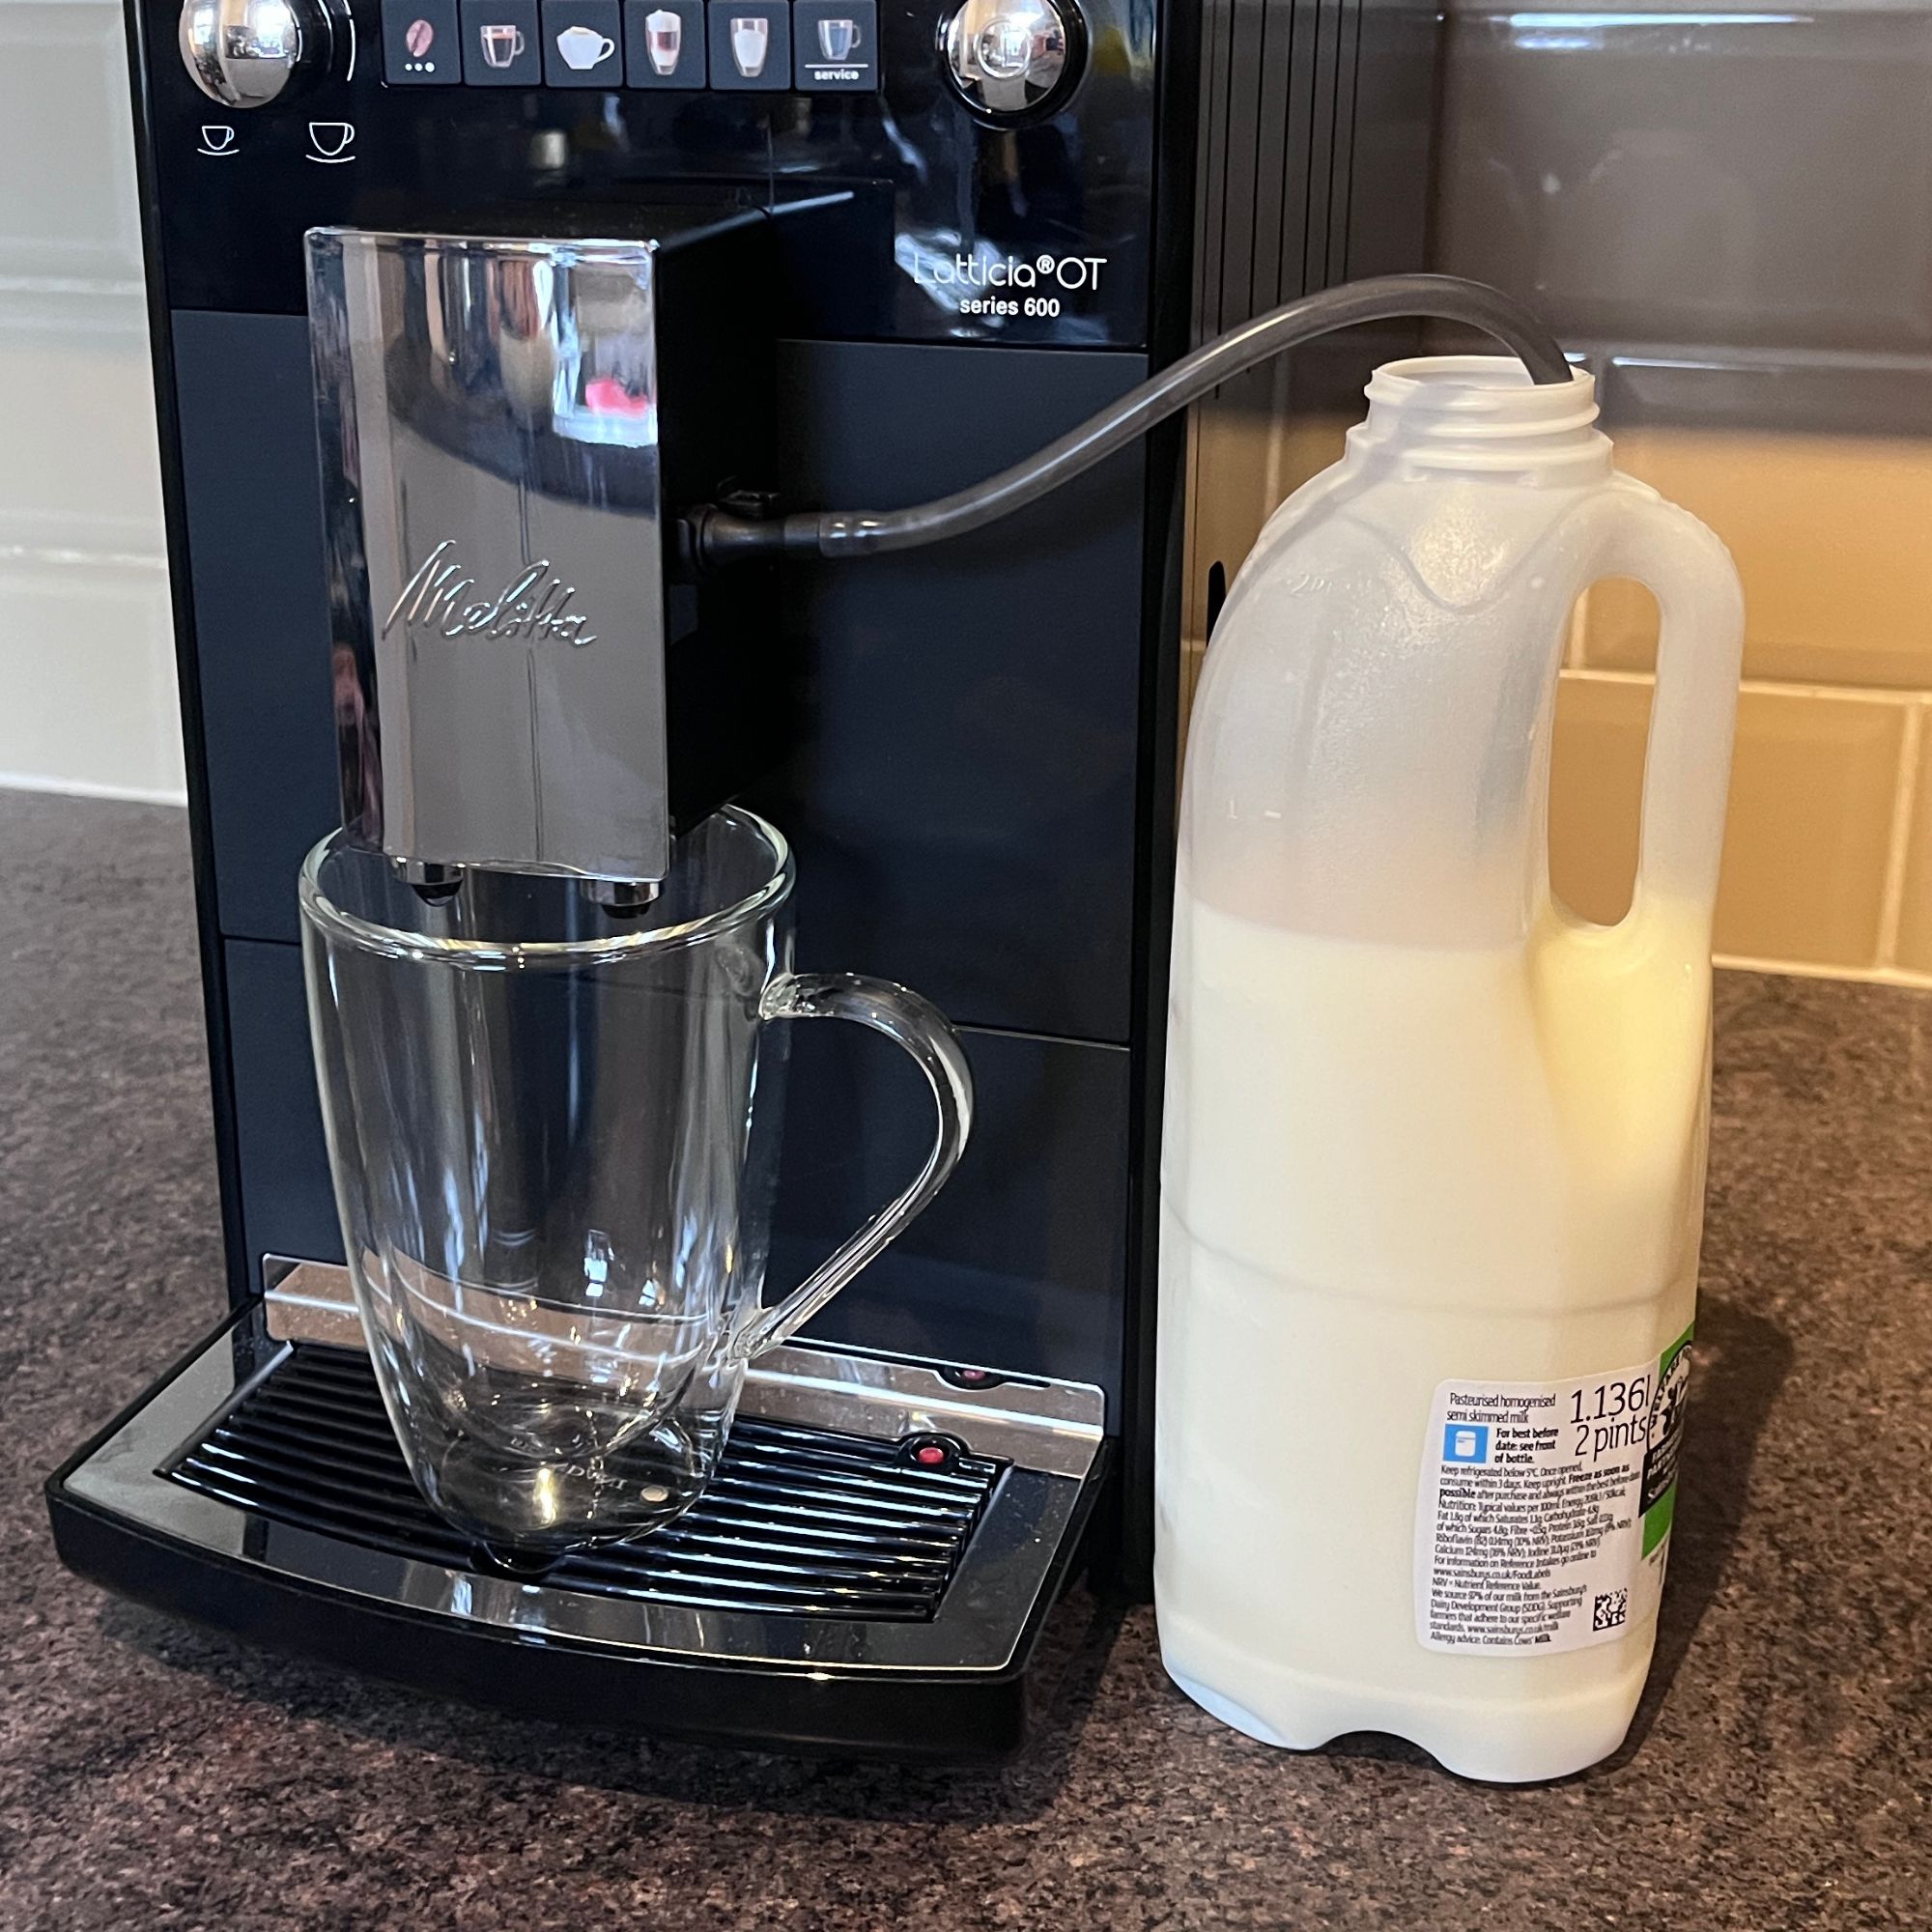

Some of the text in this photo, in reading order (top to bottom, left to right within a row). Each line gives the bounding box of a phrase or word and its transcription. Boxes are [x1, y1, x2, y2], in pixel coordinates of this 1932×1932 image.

[814, 68, 859, 80] service
[959, 296, 1061, 318] series 600
[382, 539, 598, 648] Melitta
[1449, 1392, 1556, 1413] Pasteurised homogenised
[1447, 1409, 1529, 1424] semi skimmed milk
[1496, 1427, 1559, 1438] For best before
[1575, 1425, 1590, 1457] 2
[1593, 1415, 1647, 1463] pints
[1520, 1442, 1534, 1451] see
[1534, 1440, 1556, 1451] front
[1494, 1453, 1535, 1463] of bottle.
[1440, 1478, 1473, 1487] consume
[1474, 1478, 1497, 1488] within
[1523, 1480, 1541, 1490] Keep
[1569, 1472, 1593, 1484] Freeze
[1594, 1470, 1603, 1479] as
[1604, 1466, 1620, 1477] soon
[1441, 1464, 1459, 1476] Keep
[1461, 1465, 1502, 1478] refrigerated
[1504, 1467, 1524, 1477] below
[1540, 1467, 1556, 1477] Once
[1439, 1488, 1475, 1500] possible
[1477, 1490, 1493, 1499] after
[1495, 1491, 1526, 1501] purchase
[1527, 1491, 1542, 1500] and
[1478, 1502, 1503, 1514] Typical
[1504, 1503, 1525, 1512] values
[1527, 1503, 1539, 1514] per
[1437, 1511, 1448, 1520] Fat
[1464, 1513, 1472, 1522] of
[1473, 1514, 1495, 1522] which
[1436, 1521, 1444, 1531] of
[1445, 1522, 1467, 1533] which
[1468, 1524, 1492, 1536] Sugars
[1510, 1524, 1527, 1535] Fibre
[1436, 1533, 1473, 1544] Riboflavin
[1435, 1544, 1463, 1554] Calcium
[1435, 1555, 1445, 1564] For
[1447, 1556, 1489, 1567] information
[1432, 1588, 1443, 1597] We
[1444, 1590, 1466, 1600] source
[1484, 1590, 1492, 1601] of
[1506, 1592, 1521, 1602] milk
[1523, 1591, 1540, 1602] from
[1541, 1590, 1551, 1600] the
[1431, 1599, 1450, 1611] Dairy
[1451, 1601, 1498, 1612] Development
[1500, 1603, 1520, 1614] Group
[1430, 1609, 1457, 1620] farmers
[1458, 1612, 1473, 1622] that
[1474, 1612, 1498, 1623] adhere
[1430, 1631, 1456, 1644] Allergy
[1482, 1634, 1513, 1645] Contains
